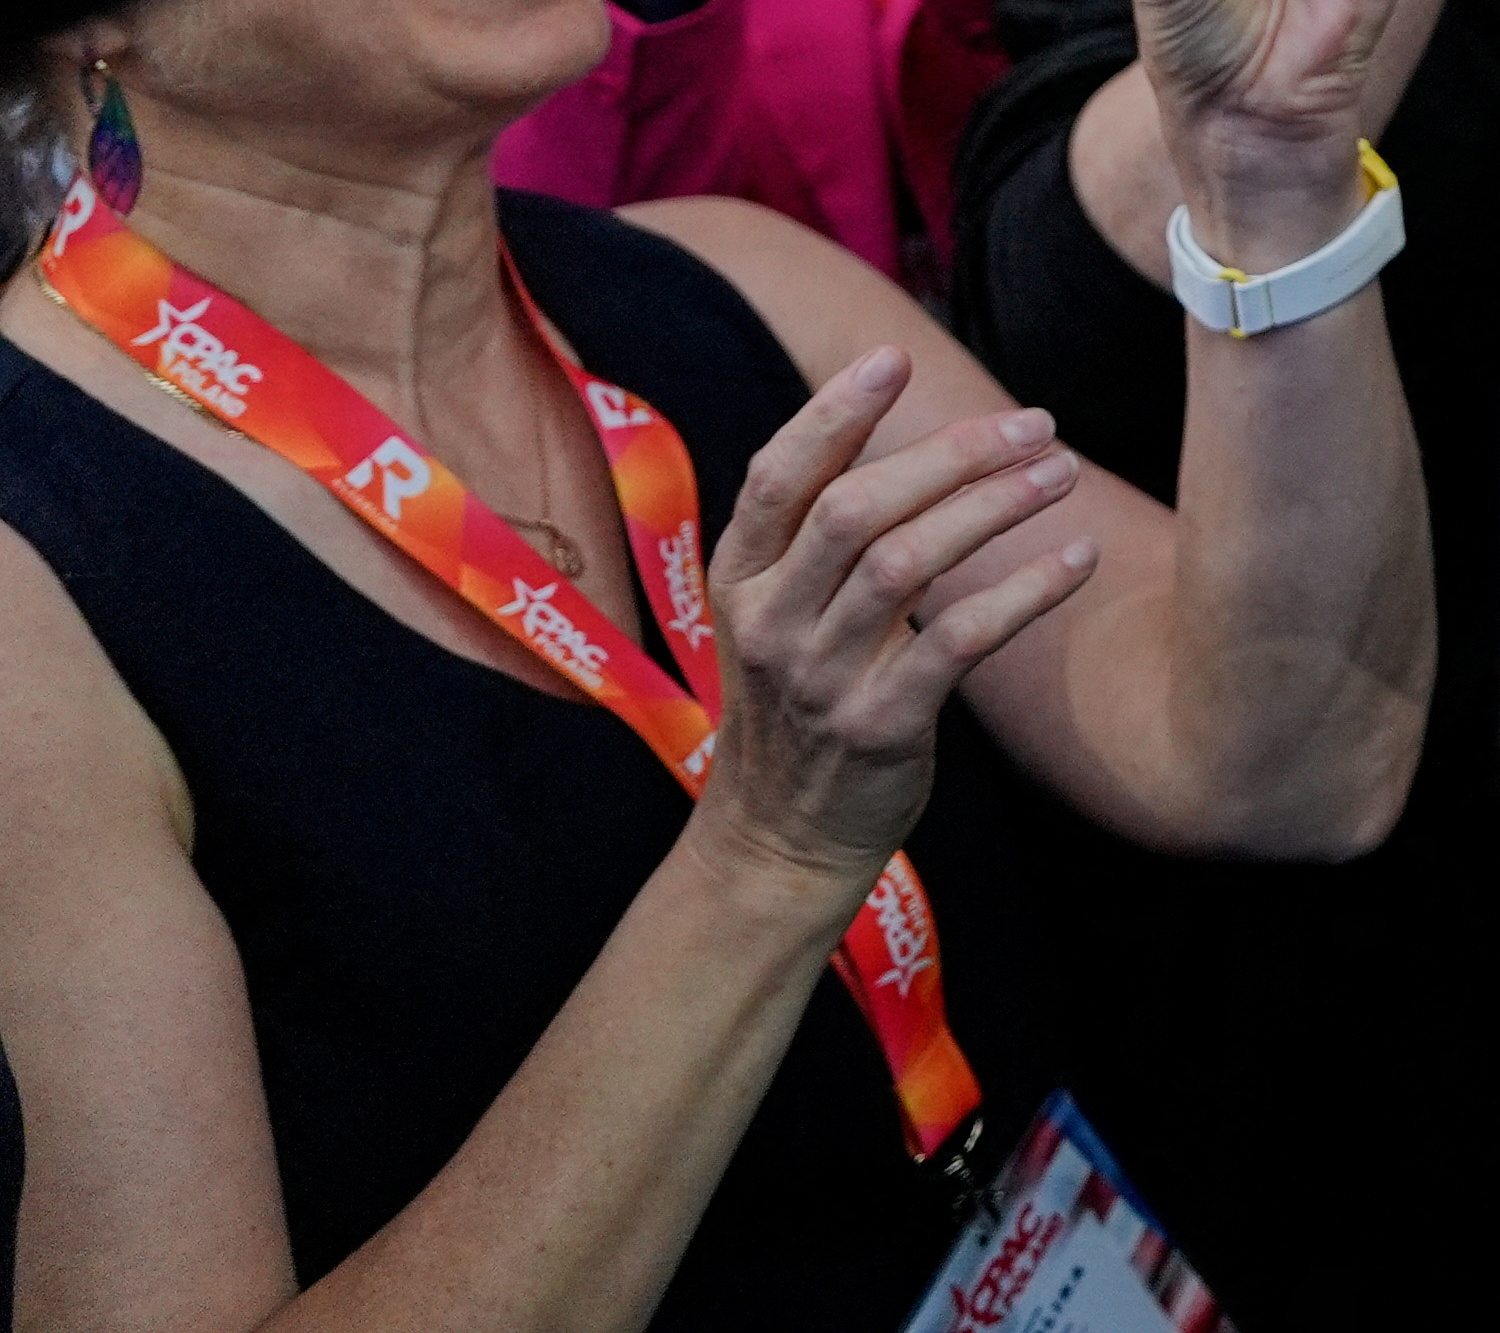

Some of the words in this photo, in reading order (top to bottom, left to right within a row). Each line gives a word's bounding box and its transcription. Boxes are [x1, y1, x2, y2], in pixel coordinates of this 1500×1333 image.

[162, 321, 263, 395] CPAC
[169, 360, 248, 418] POLAND
[344, 435, 432, 521] R
[523, 599, 610, 671] CPAC
